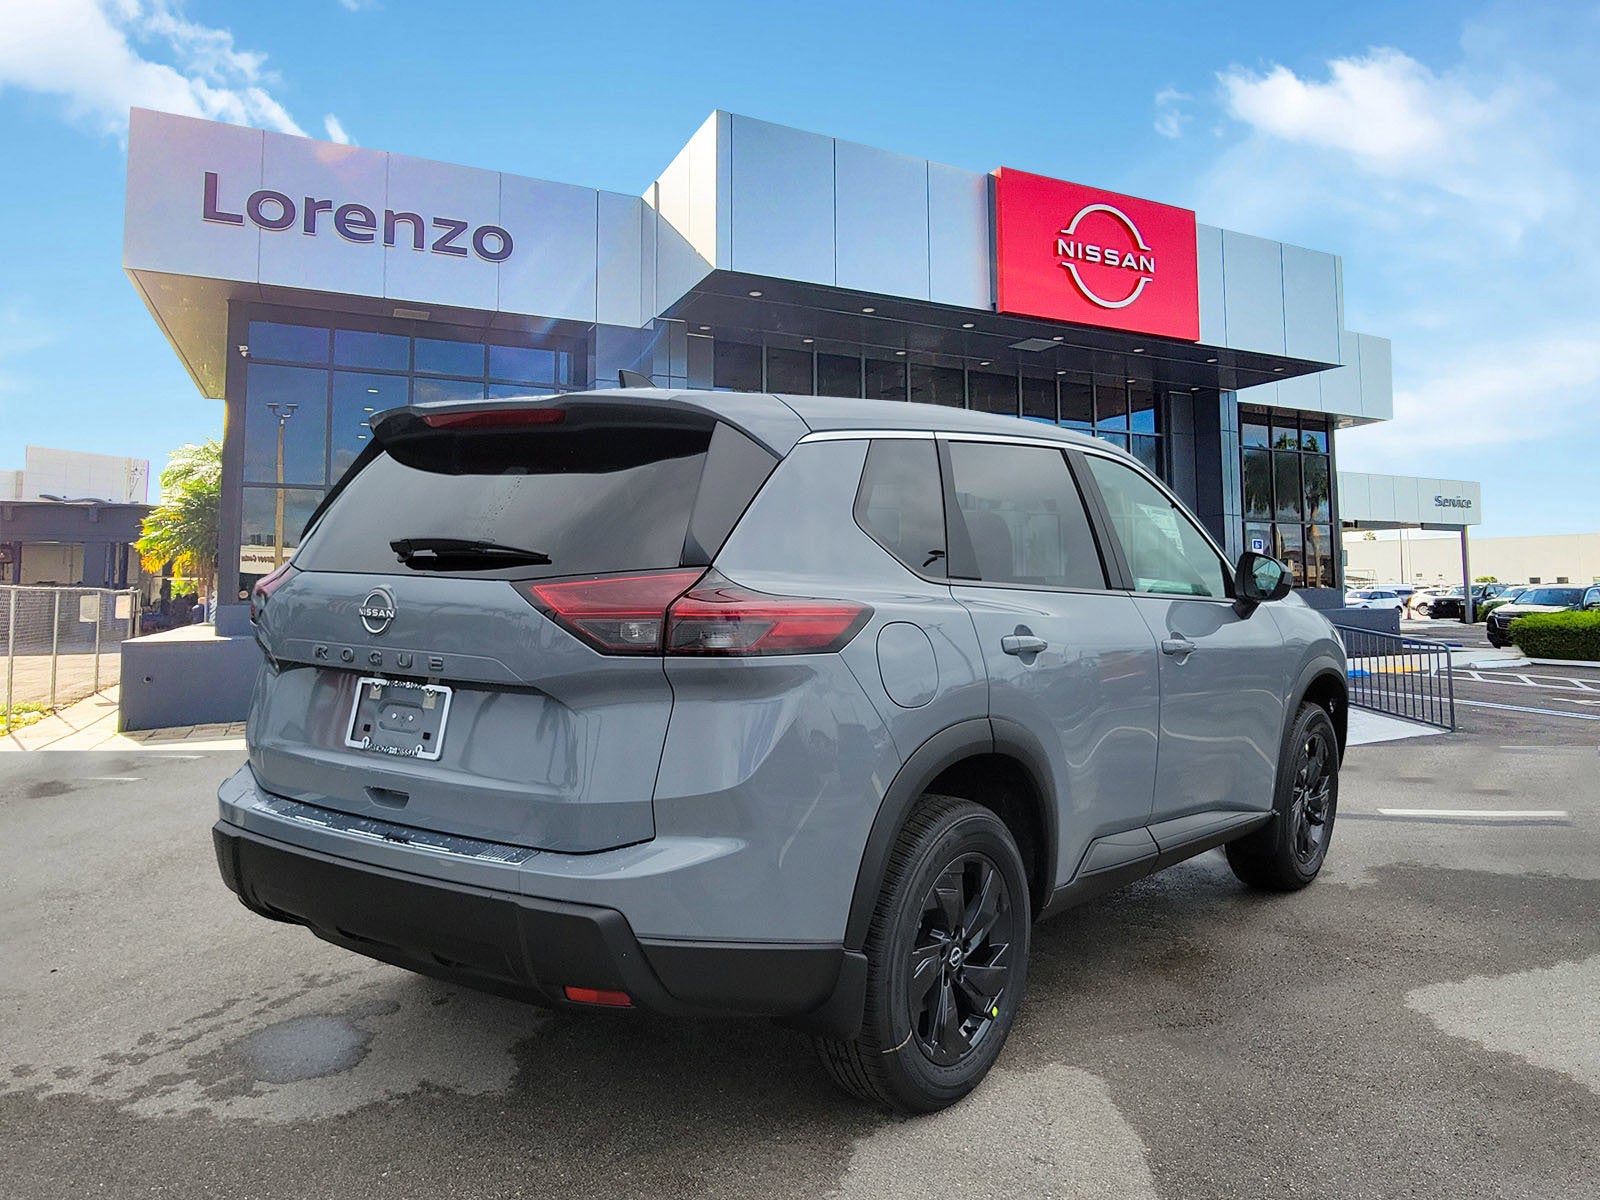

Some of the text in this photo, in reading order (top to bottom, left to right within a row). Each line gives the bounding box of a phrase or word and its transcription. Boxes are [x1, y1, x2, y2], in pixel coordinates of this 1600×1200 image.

[202, 171, 514, 262] Lorenzo
[1057, 238, 1155, 273] NISSAN
[1434, 495, 1472, 509] Service
[359, 607, 394, 618] NISSAN
[313, 644, 444, 671] ROGUE
